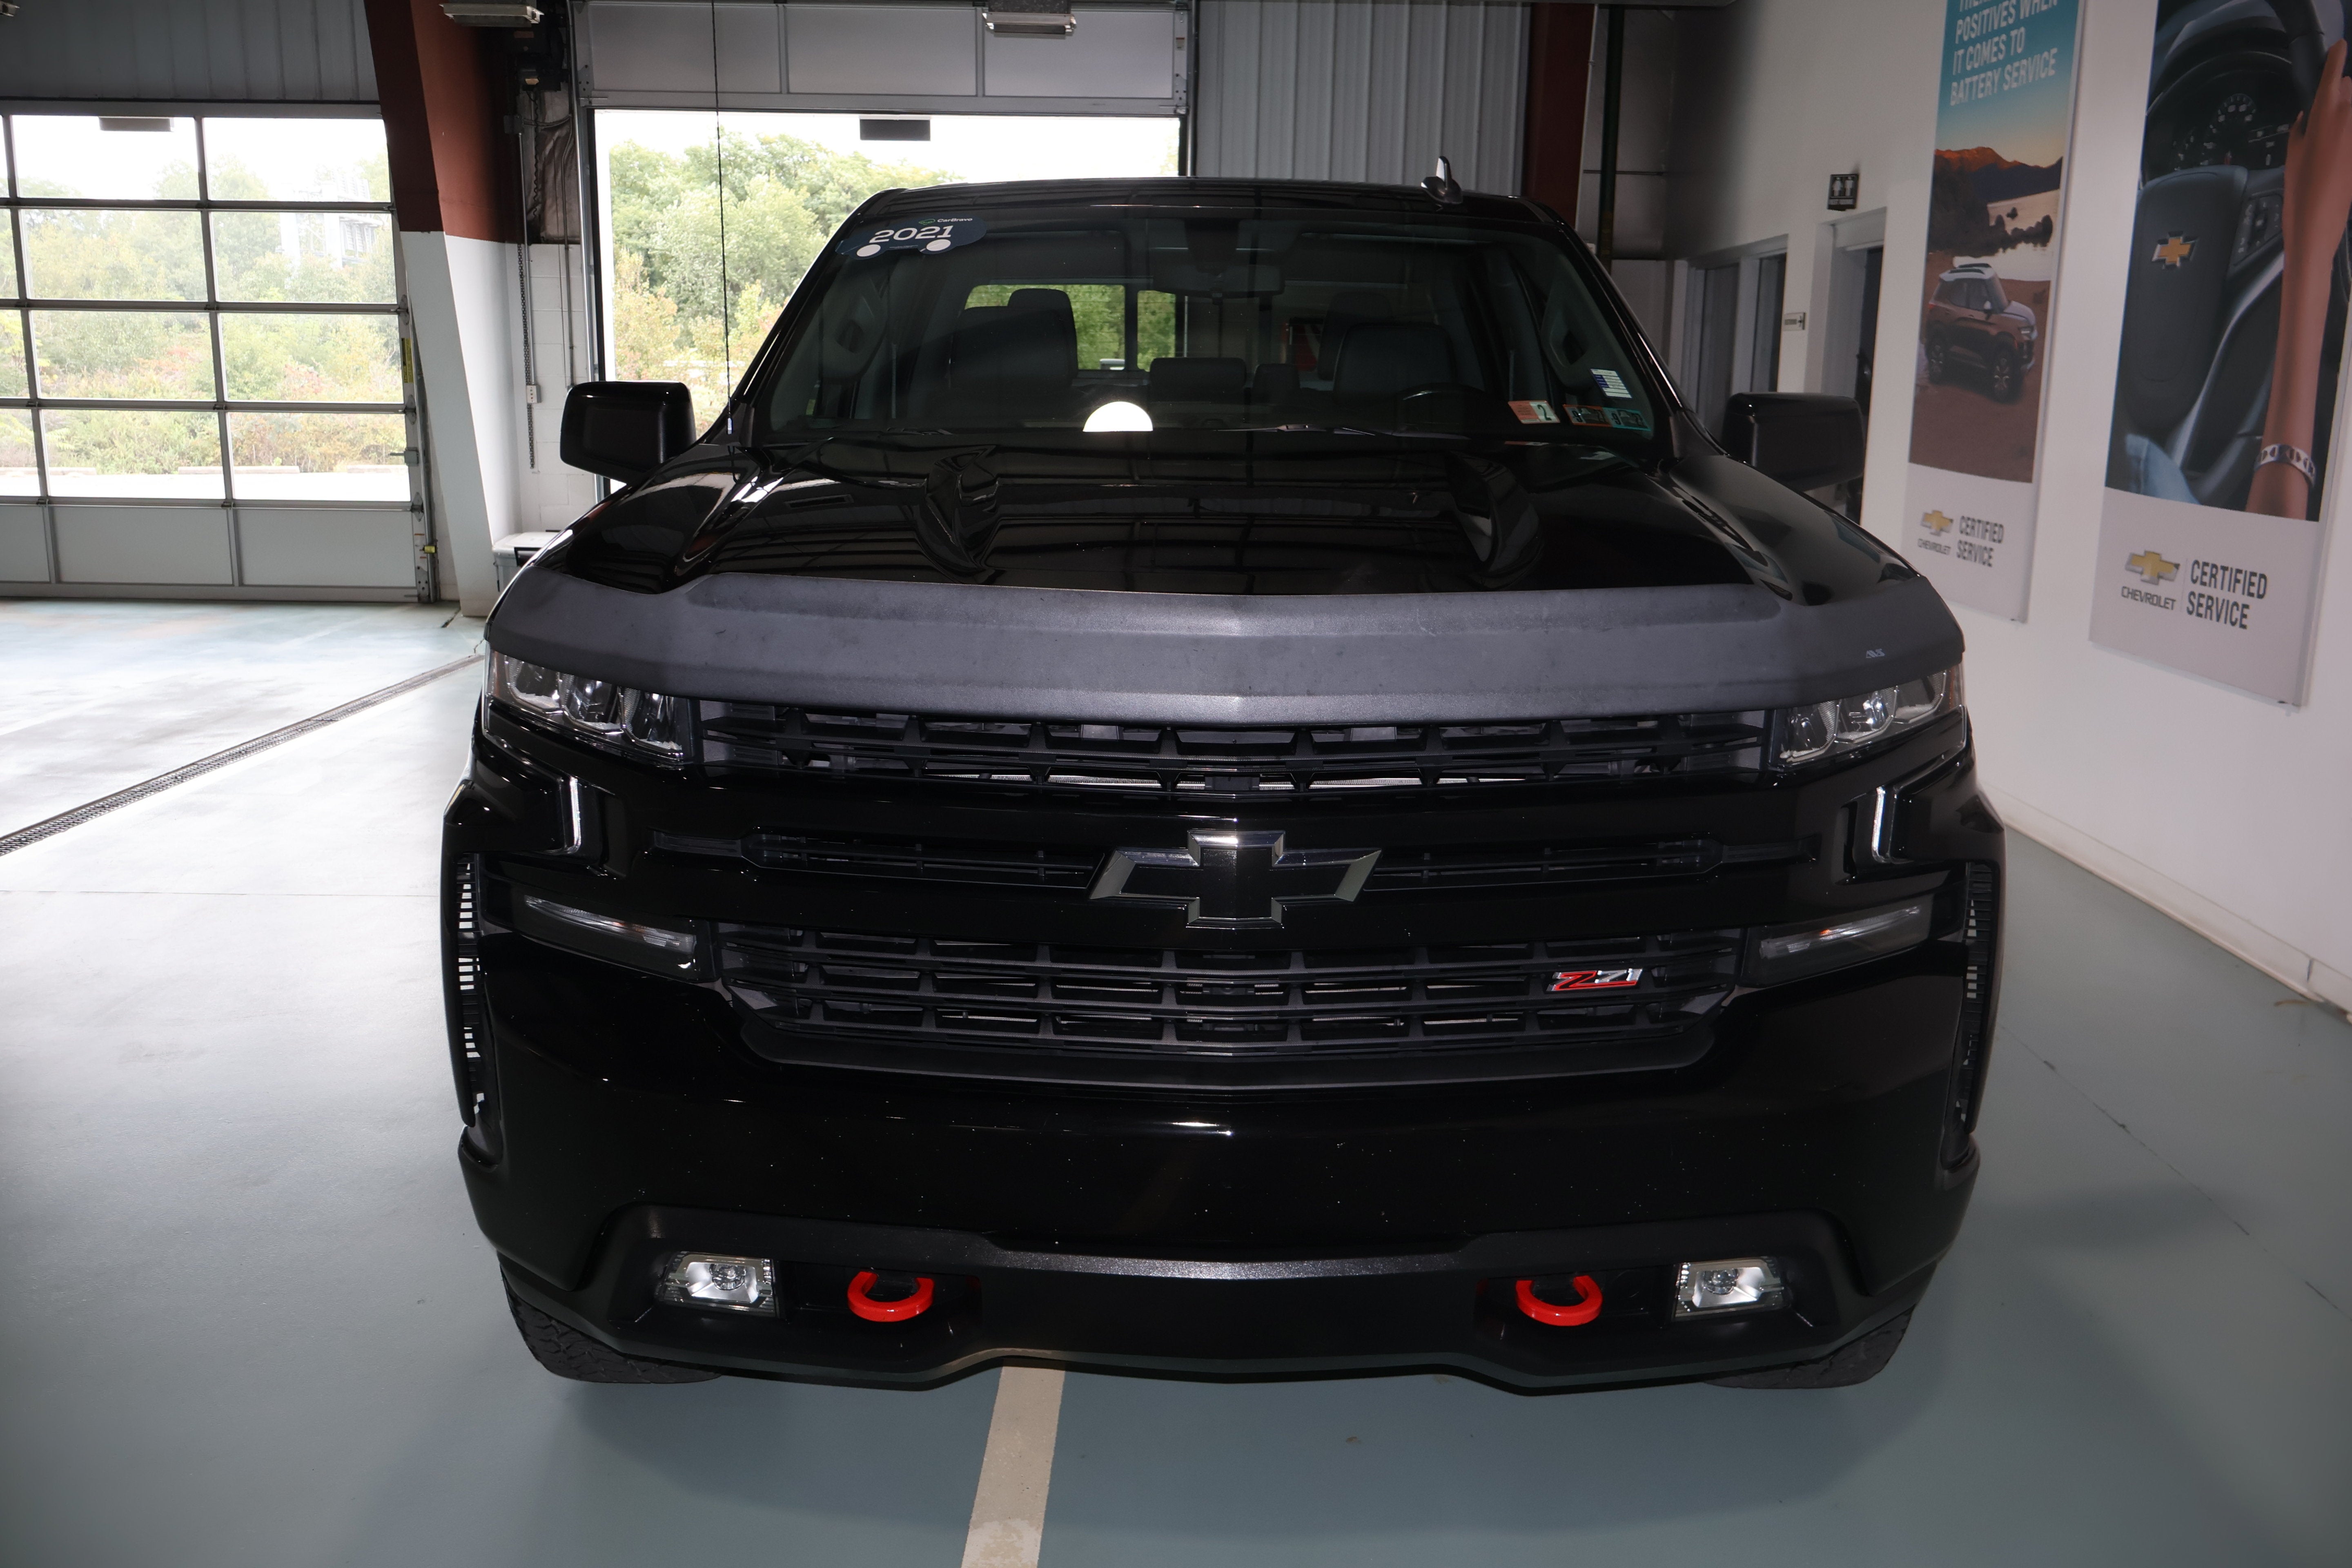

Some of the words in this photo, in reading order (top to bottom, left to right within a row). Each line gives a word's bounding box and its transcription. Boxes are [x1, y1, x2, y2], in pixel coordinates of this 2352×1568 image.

[1956, 0, 2016, 44] POSITIVES
[2020, 0, 2057, 19] WH
[1953, 49, 1965, 76] IT
[1966, 33, 2007, 71] COMES
[2010, 27, 2026, 56] TO
[1950, 68, 2001, 106] BATTERY
[2003, 47, 2058, 91] SERVICE
[869, 225, 953, 243] 2021
[1537, 404, 1552, 421] 2
[1960, 515, 2004, 544] CERTIFIED
[1956, 539, 1994, 567] SERVICE
[2190, 559, 2267, 599] CERTIFIED
[2121, 586, 2176, 610] CHEVROLET
[2186, 591, 2250, 629] SERVICE
[1546, 968, 1643, 991] Z71
